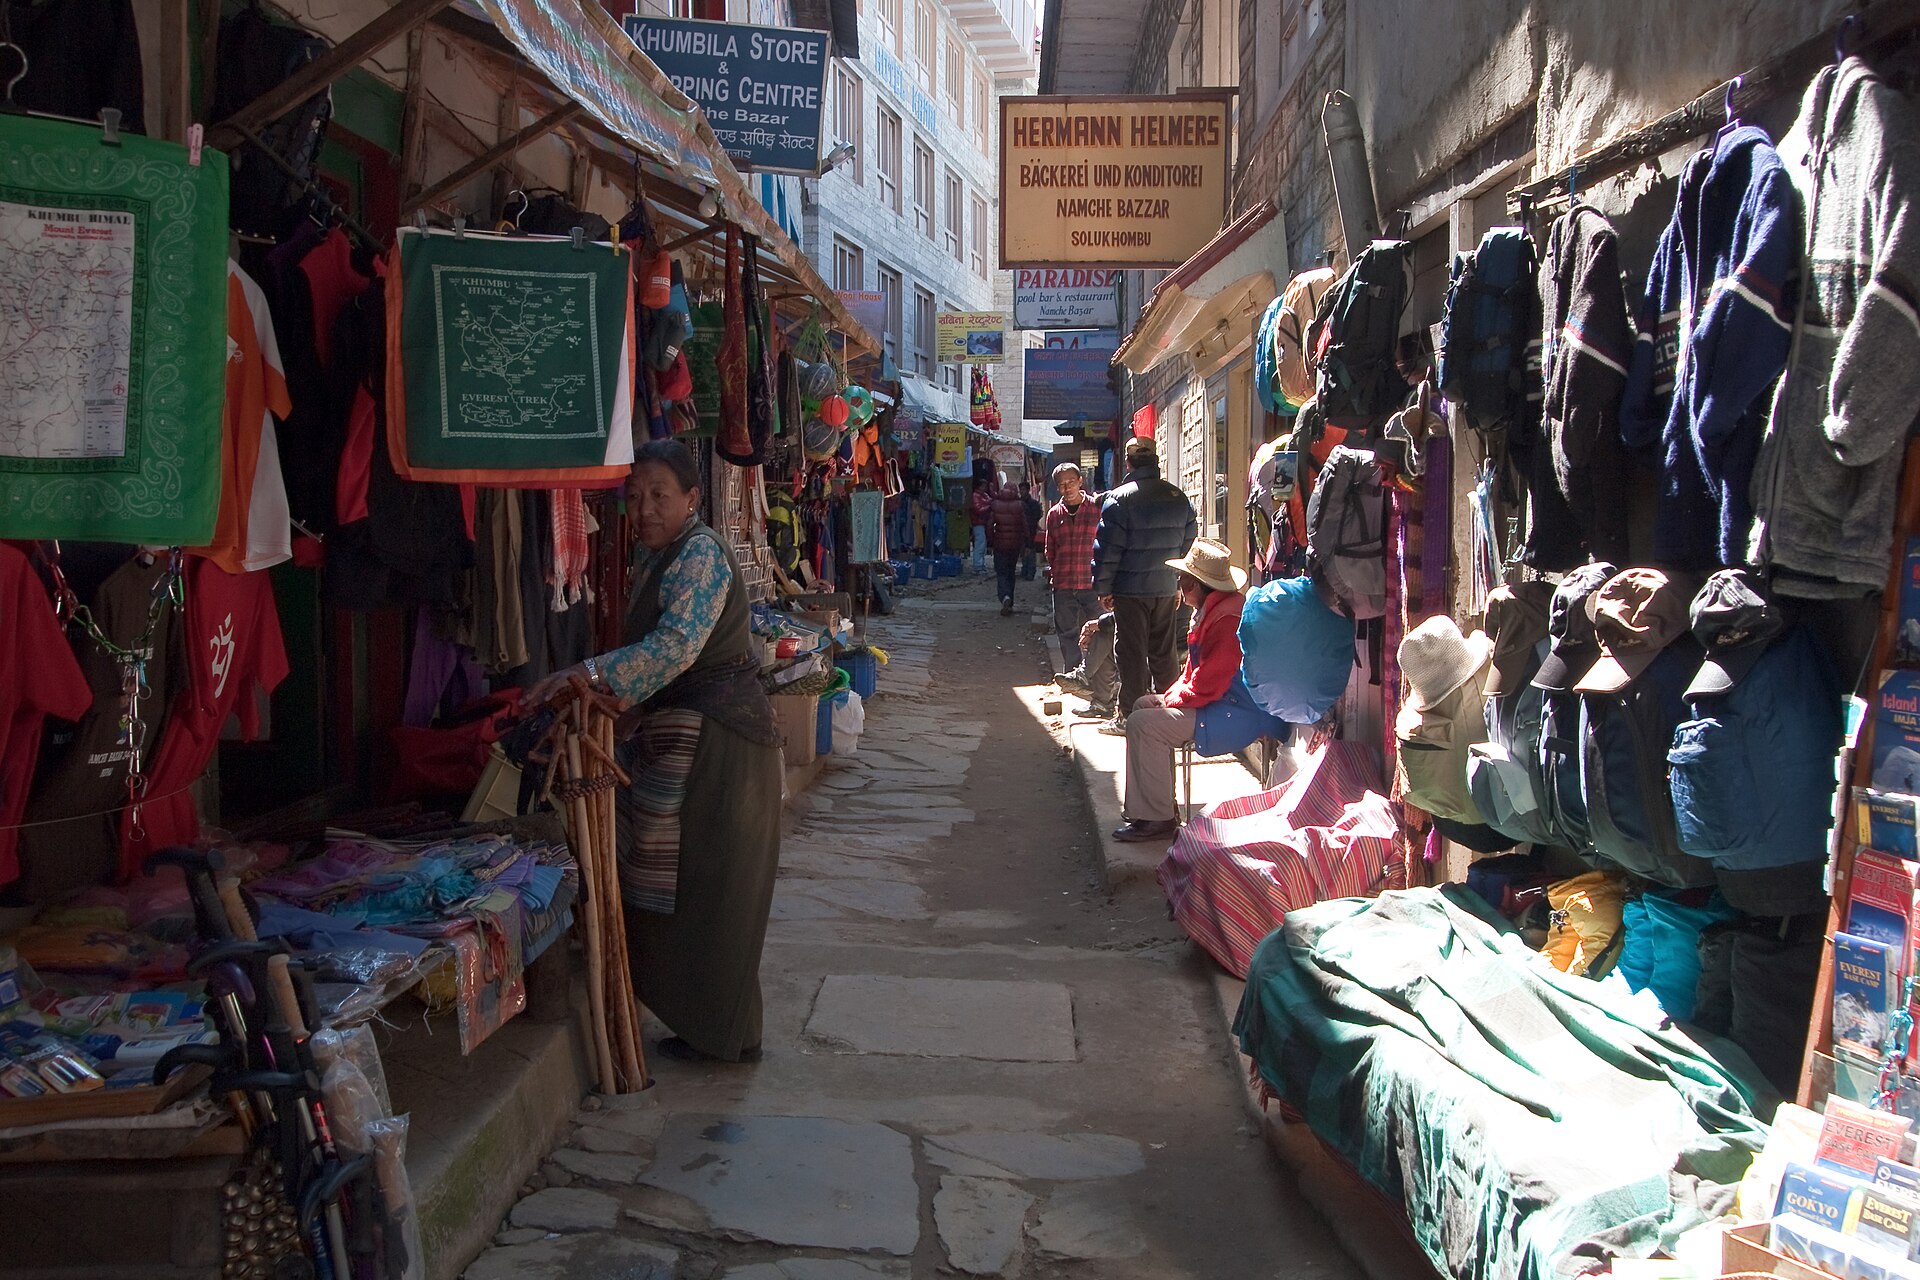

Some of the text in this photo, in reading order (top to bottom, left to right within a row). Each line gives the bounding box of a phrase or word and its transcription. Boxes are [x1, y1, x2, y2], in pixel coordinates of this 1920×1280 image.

[632, 23, 819, 65] KHUMBILA STORE
[718, 61, 729, 75] &
[671, 75, 818, 110] PPING CENTRE
[702, 107, 790, 125] he Bazar
[1013, 115, 1220, 148] HERMANN HELMERS
[1093, 165, 1122, 187] UND
[1124, 164, 1203, 188] KONDITOREI
[28, 209, 131, 225] KHUMBU HIMAL
[1056, 198, 1170, 219] NAMCHE BAZZAR
[43, 223, 113, 236] Mount Everest
[1071, 230, 1151, 247] SOLUKHOMBU
[461, 277, 511, 288] KHUMBU
[1017, 269, 1117, 289] PARADISE
[468, 286, 506, 297] HIMAL
[858, 292, 882, 302] House
[1017, 292, 1036, 305] pool
[1039, 291, 1055, 303] bar
[1064, 291, 1115, 302] restaurant
[1040, 305, 1094, 317] Namche Bazar
[461, 393, 548, 405] EVEREST TREK
[943, 436, 960, 444] VISA
[1882, 692, 1917, 712] Island
[1839, 961, 1882, 982] EVEREST
[1825, 1120, 1895, 1150] EVEREST
[1824, 1136, 1853, 1153] BASE
[1786, 1190, 1839, 1219] GOKYO
